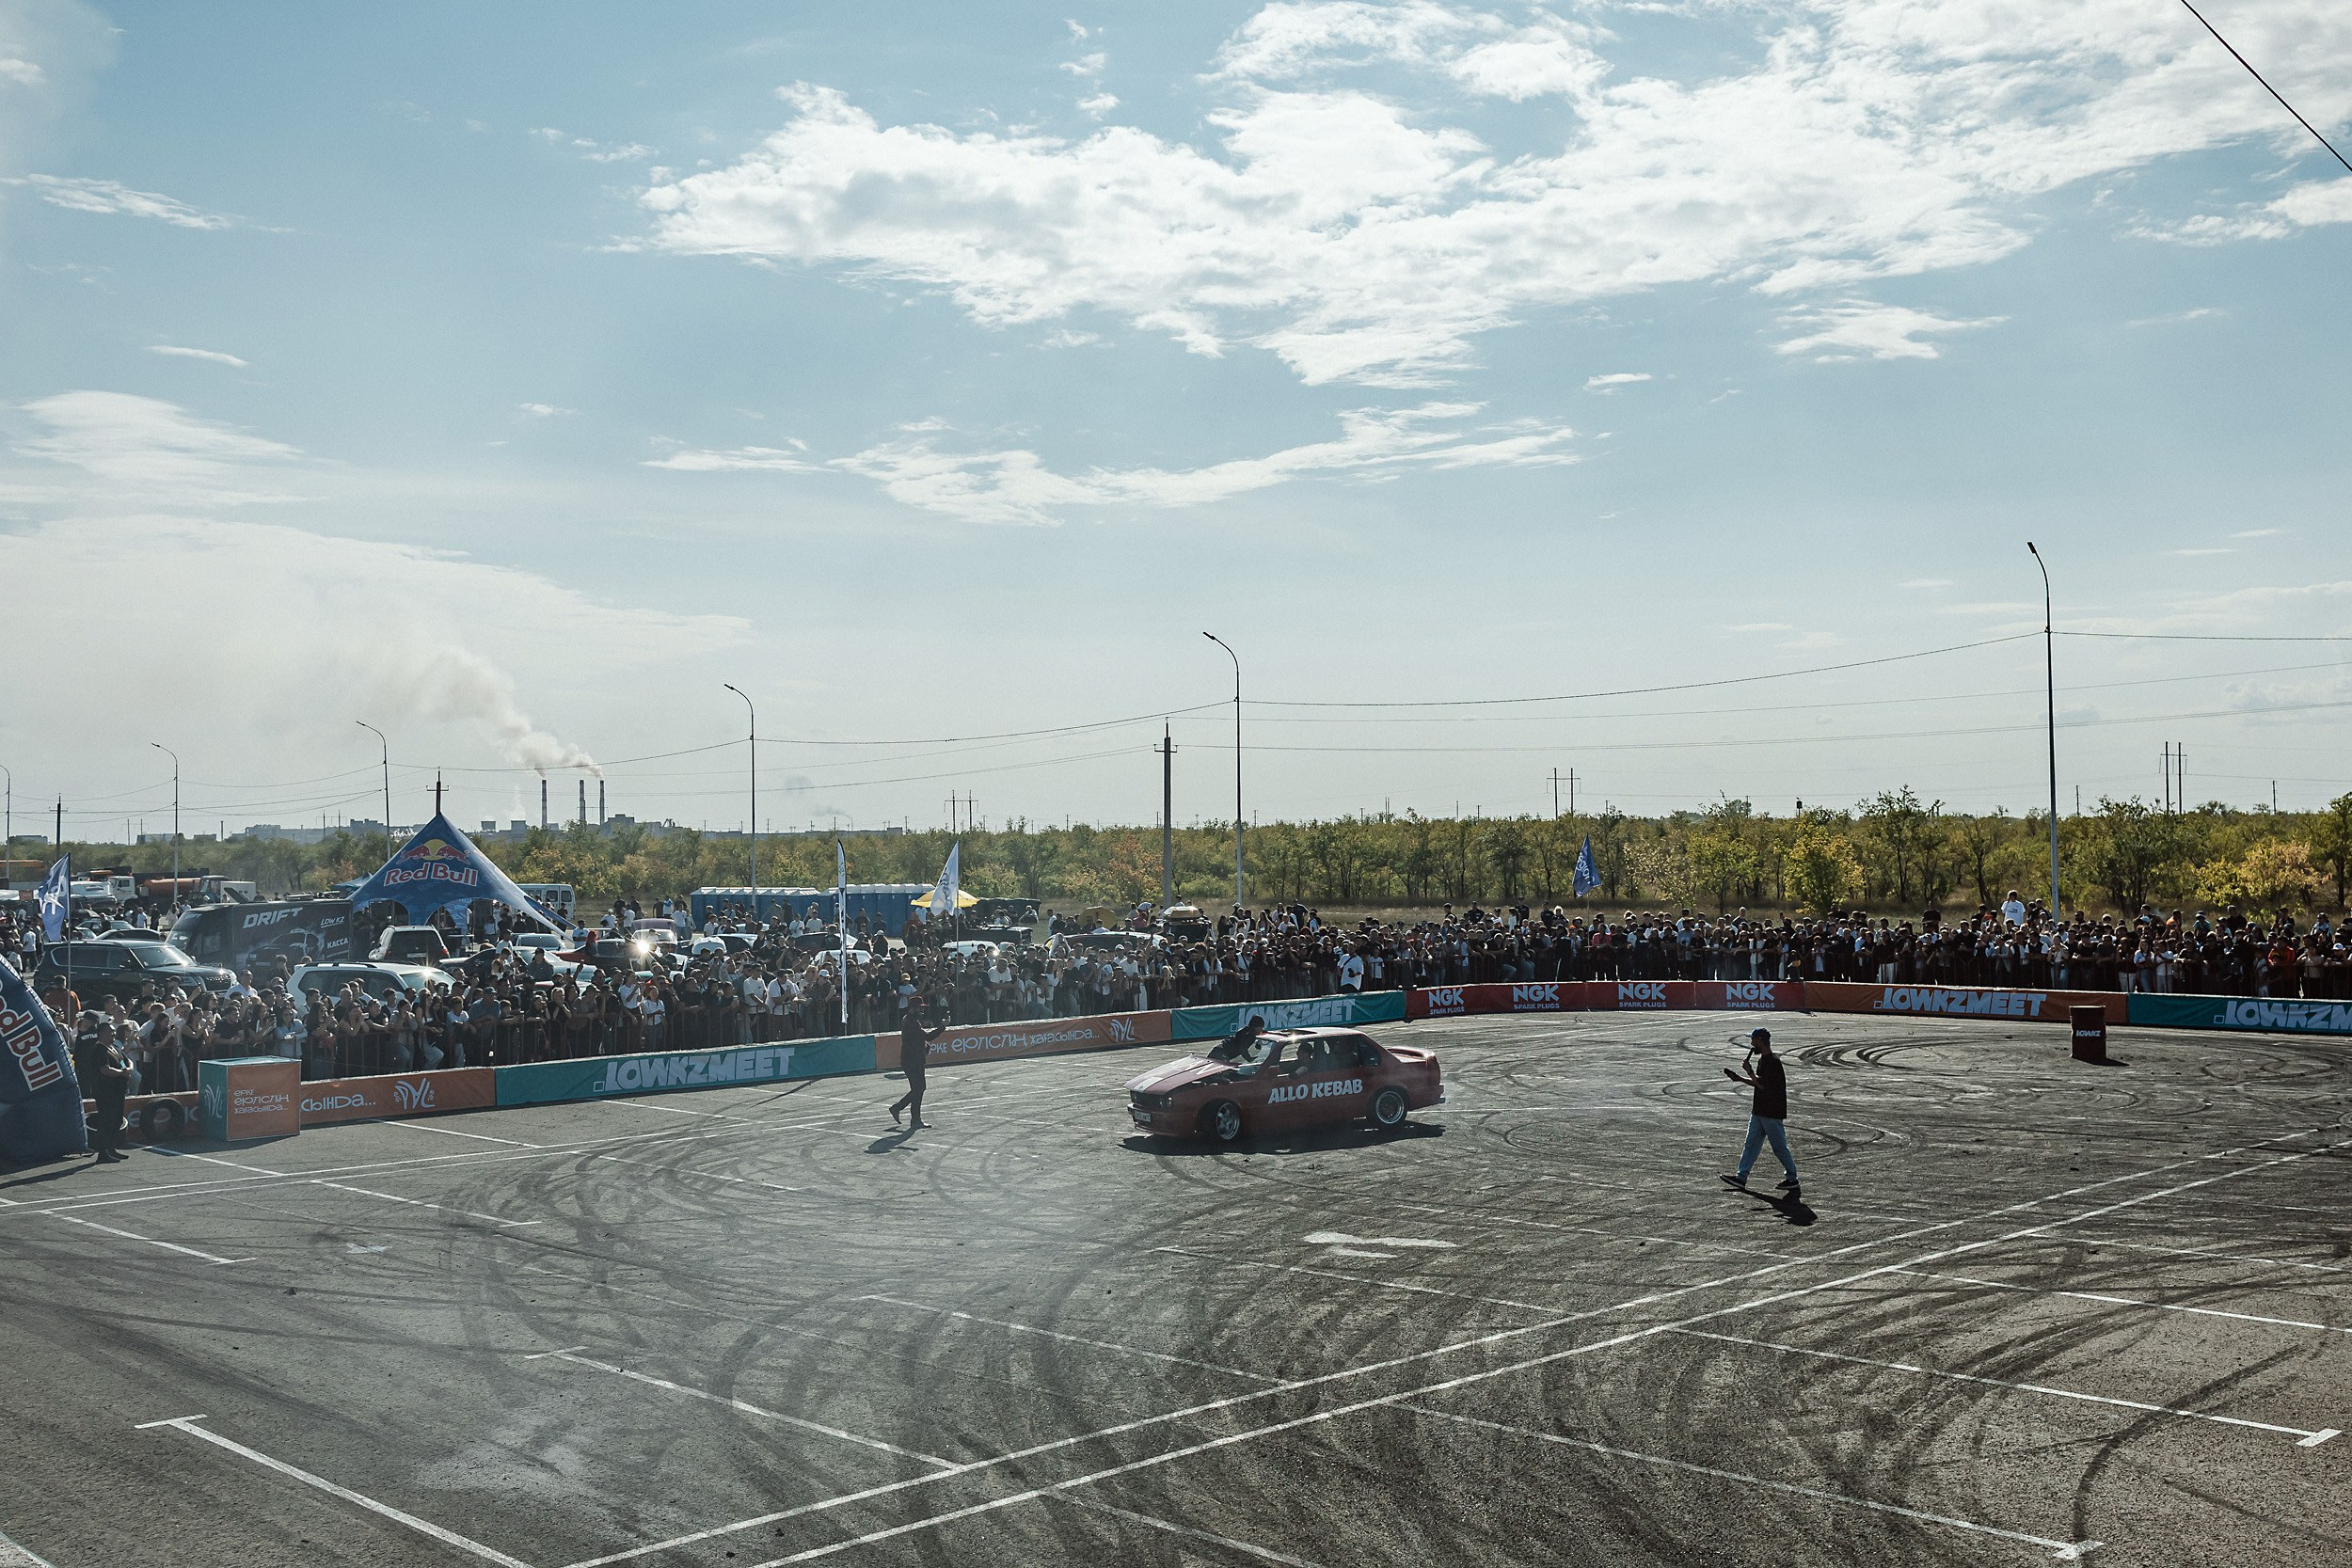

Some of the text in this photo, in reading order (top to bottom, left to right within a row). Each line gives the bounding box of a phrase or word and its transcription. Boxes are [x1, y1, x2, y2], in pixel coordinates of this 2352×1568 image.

[383, 863, 479, 887] Red Bull
[243, 907, 303, 929] DRIFT
[326, 937, 349, 949] КАССА
[1428, 988, 1465, 1007] NGK
[1513, 984, 1559, 1002] NGK
[1618, 983, 1666, 1000] NGK
[1725, 983, 1775, 1001] NGK
[7, 1024, 64, 1092] Bull
[1267, 1079, 1363, 1104] ALLO KEBAB
